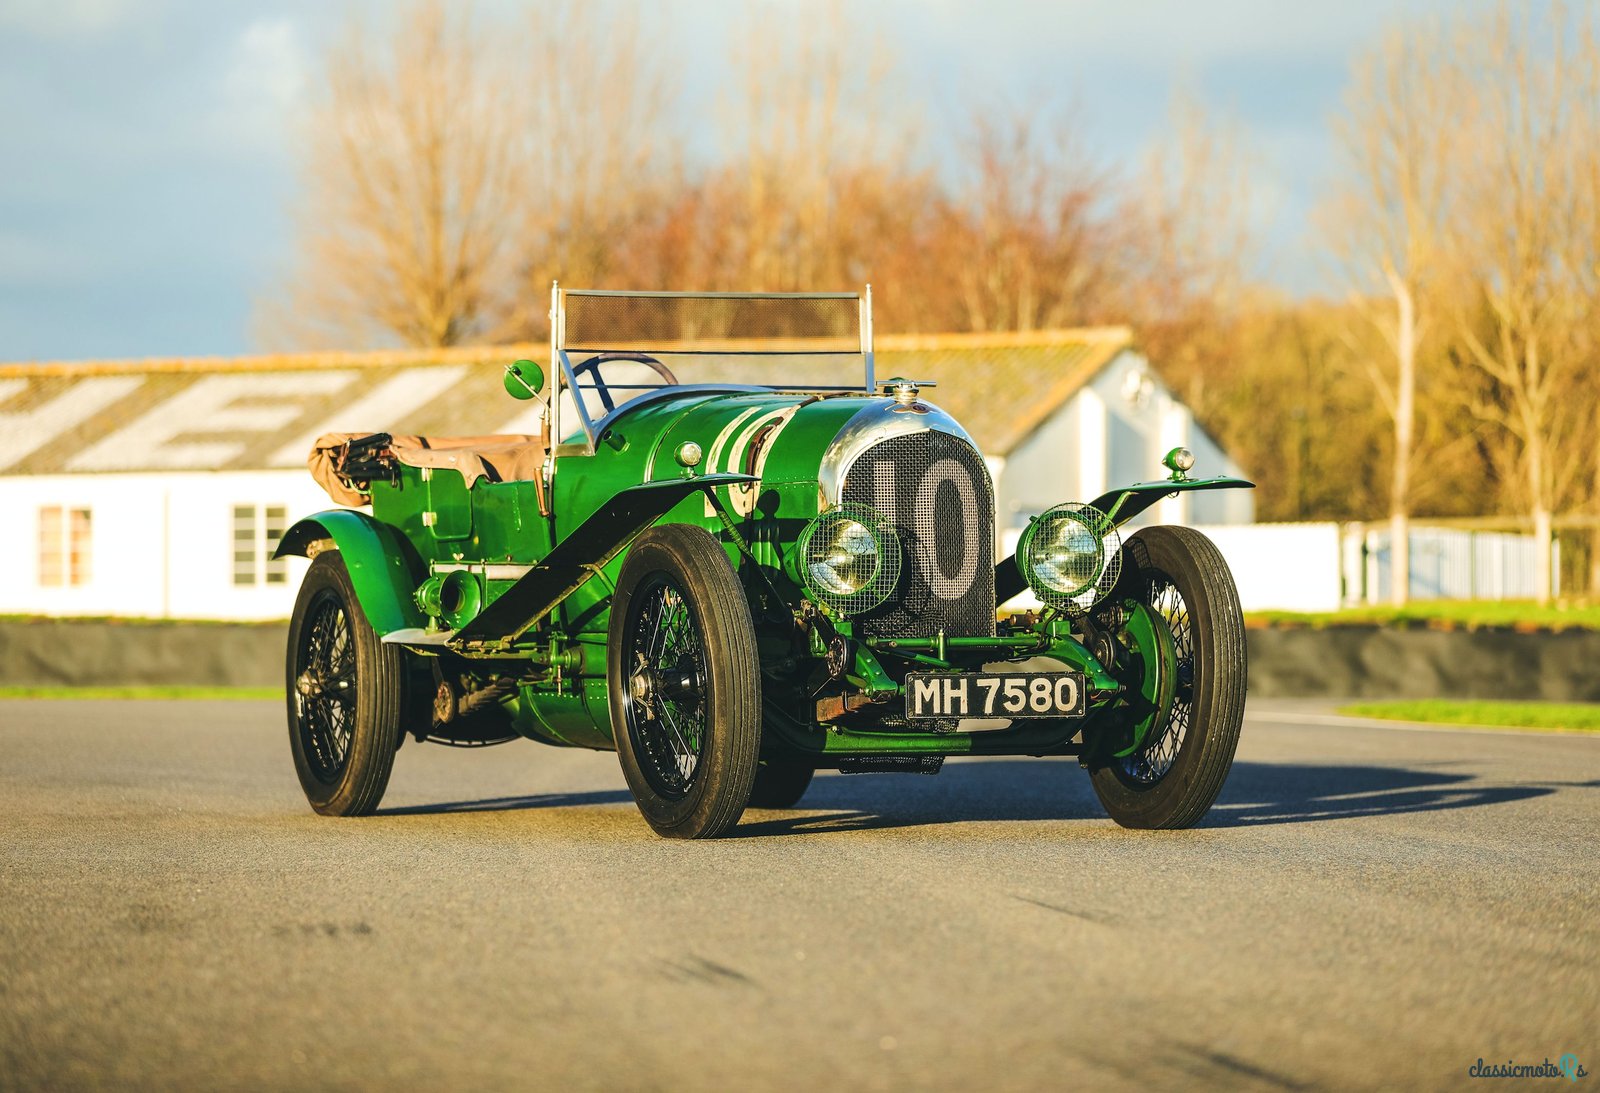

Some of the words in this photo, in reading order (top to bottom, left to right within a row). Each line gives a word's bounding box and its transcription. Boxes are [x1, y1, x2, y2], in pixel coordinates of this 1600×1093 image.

[705, 406, 798, 518] 10
[874, 459, 979, 600] 10
[914, 678, 968, 714] MH
[976, 677, 1078, 713] 7580
